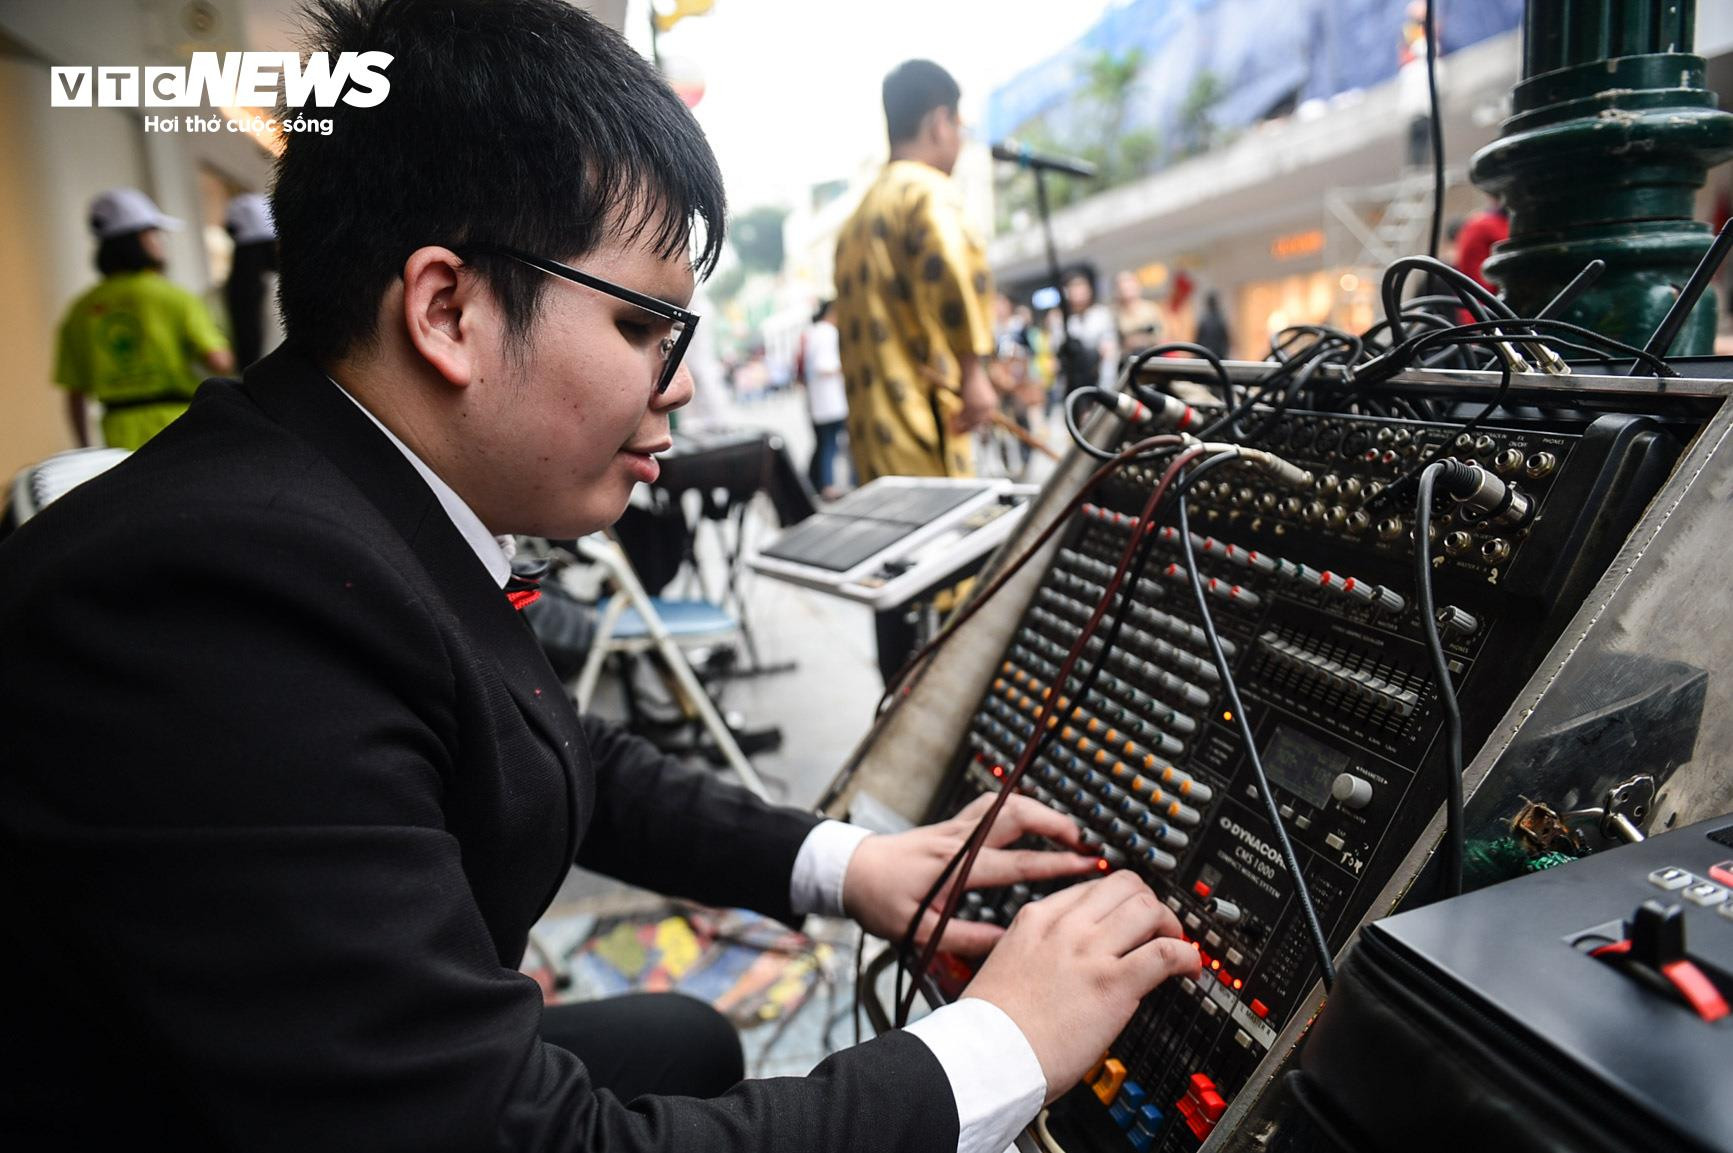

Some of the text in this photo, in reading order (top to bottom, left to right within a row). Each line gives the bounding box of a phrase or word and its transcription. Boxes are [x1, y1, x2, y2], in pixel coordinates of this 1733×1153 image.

[1230, 823, 1287, 871] DYNACOR
[1235, 846, 1275, 879] CMS 1000
[1259, 879, 1281, 899] SYSTEM
